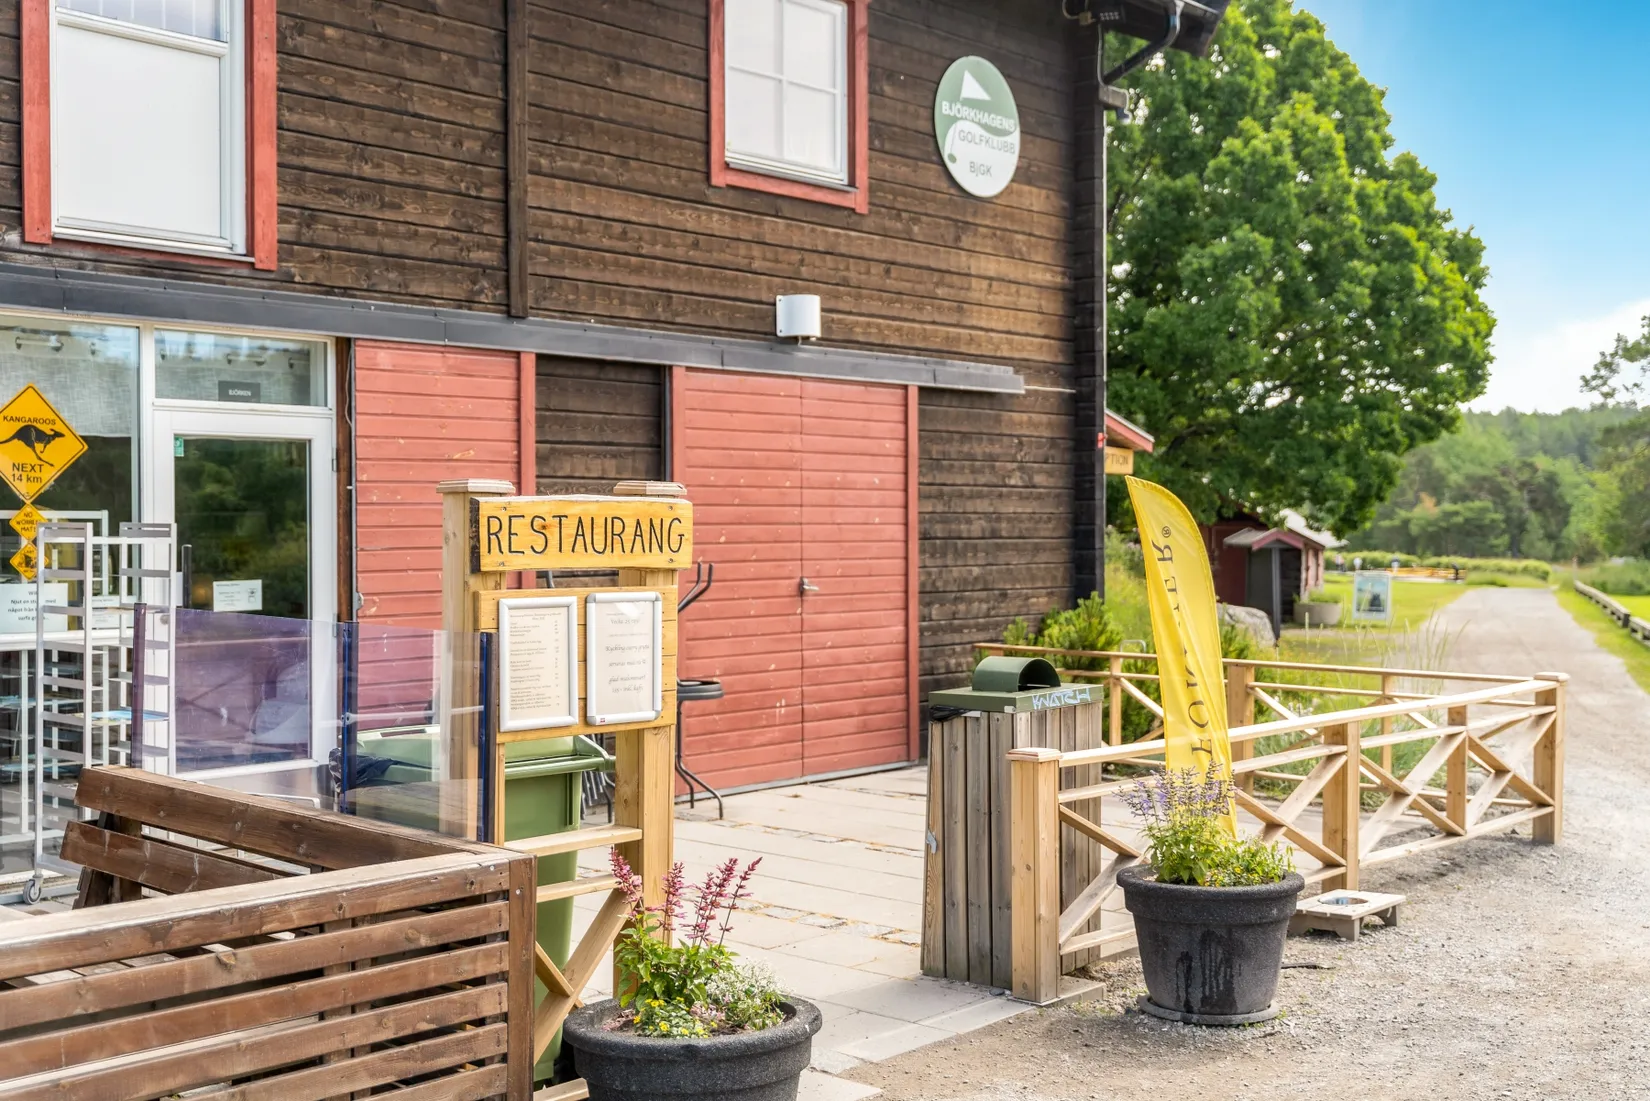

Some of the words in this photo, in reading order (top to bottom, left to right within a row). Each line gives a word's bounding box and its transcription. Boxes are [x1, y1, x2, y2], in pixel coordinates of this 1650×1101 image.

[941, 101, 1015, 131] BJÖRKHAGENS
[958, 129, 1016, 155] GOLFKLUBB
[2, 414, 57, 426] KANGAROOS
[12, 462, 44, 473] NEXT
[11, 473, 23, 483] 14
[26, 474, 43, 484] km
[486, 515, 685, 555] RESTAURANG
